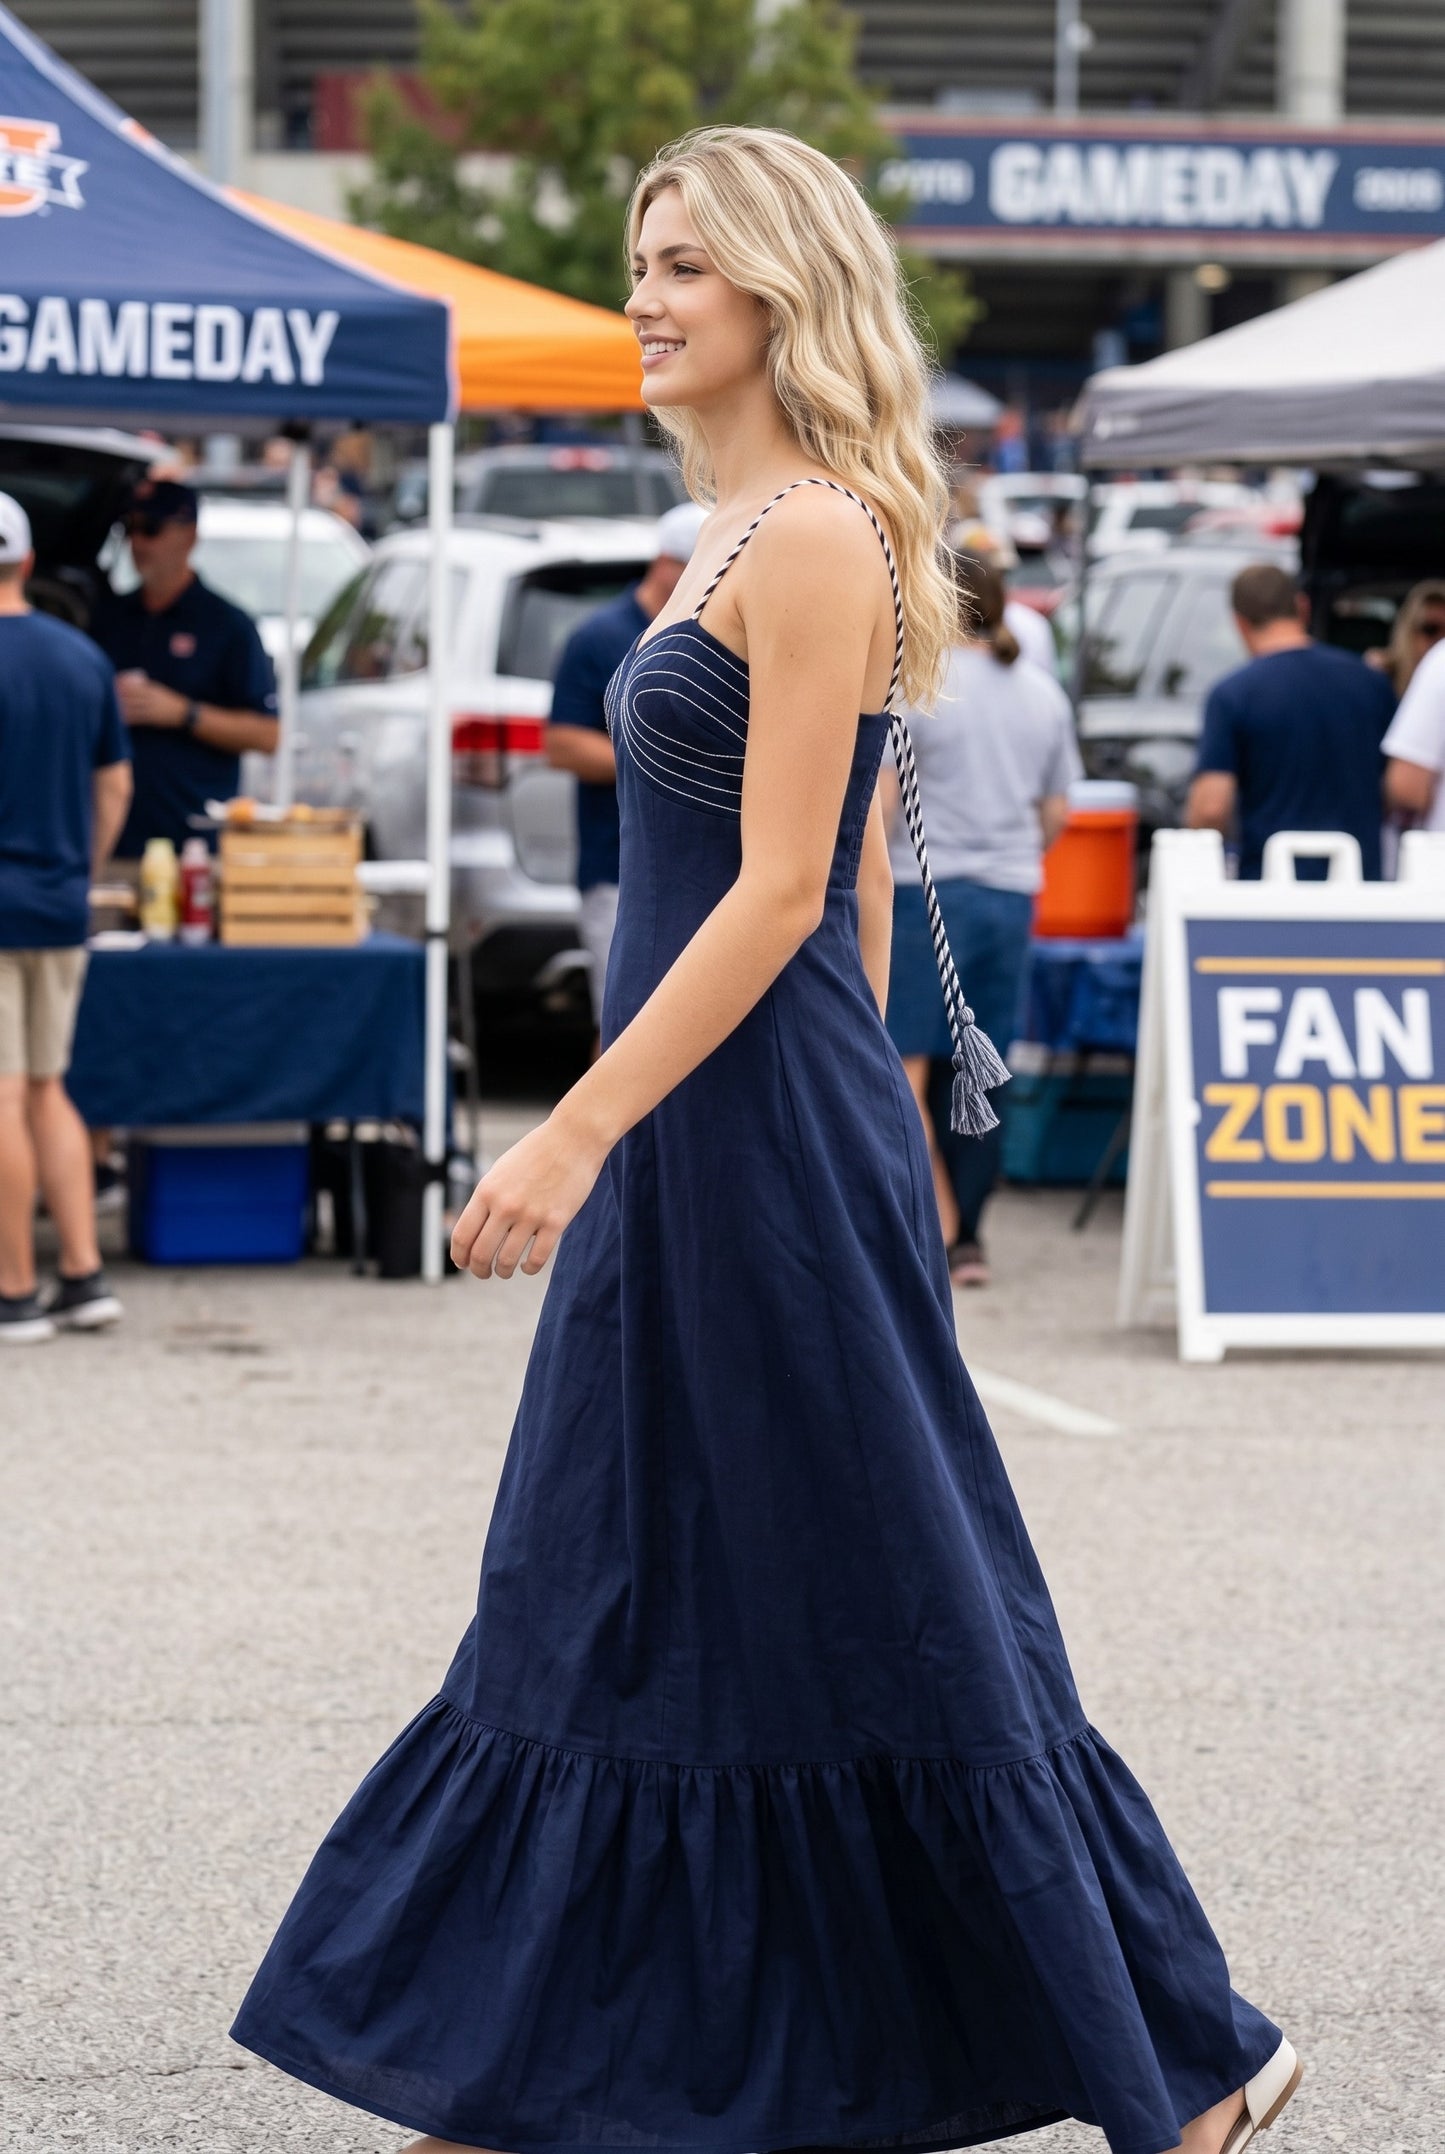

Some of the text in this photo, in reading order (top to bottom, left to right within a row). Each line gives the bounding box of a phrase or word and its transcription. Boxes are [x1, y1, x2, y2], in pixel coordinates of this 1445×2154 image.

[989, 141, 1338, 229] GAMEDAY
[0, 294, 340, 386] GAMEDAY
[1216, 987, 1434, 1079] FAN
[1203, 1083, 1445, 1164] ZONE
